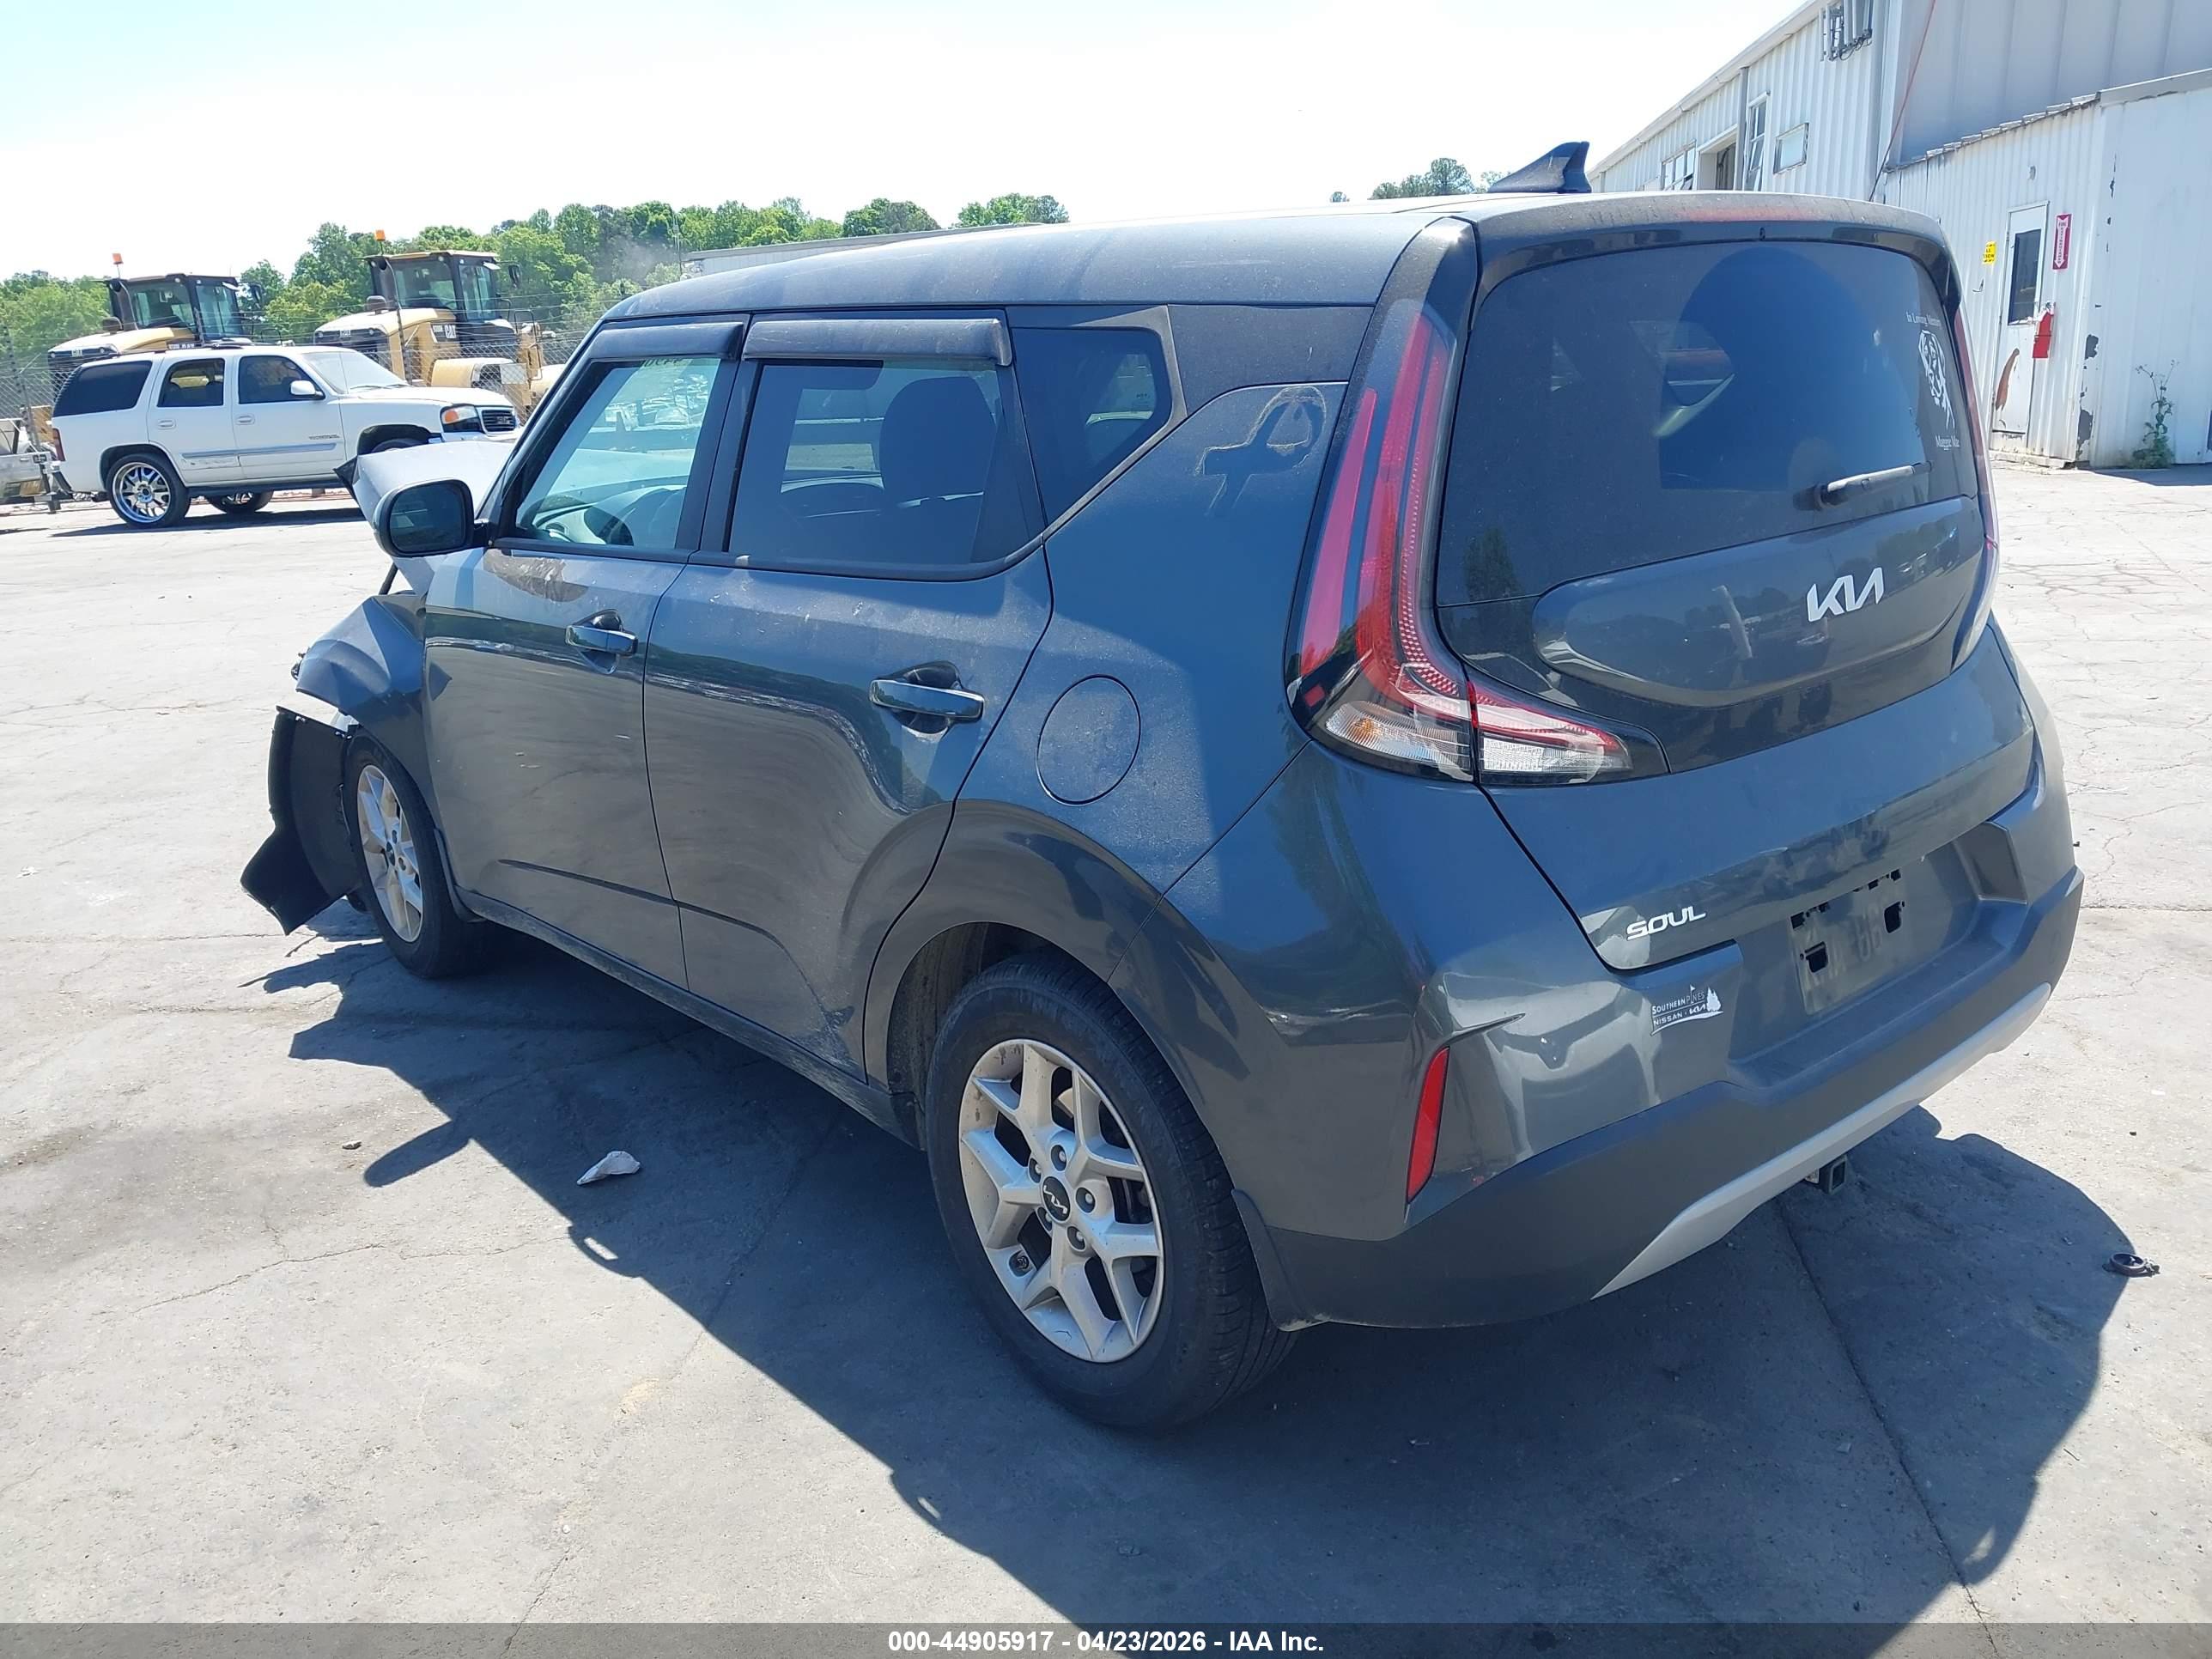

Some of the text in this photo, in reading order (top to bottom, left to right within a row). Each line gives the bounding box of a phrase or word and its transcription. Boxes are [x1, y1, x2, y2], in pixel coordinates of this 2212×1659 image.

[1806, 567, 1885, 623] KIA
[1626, 906, 1707, 940] SOUL
[1651, 990, 1705, 1015] SOUTHERN PINES
[1653, 1003, 1706, 1026] NISSAN KIA
